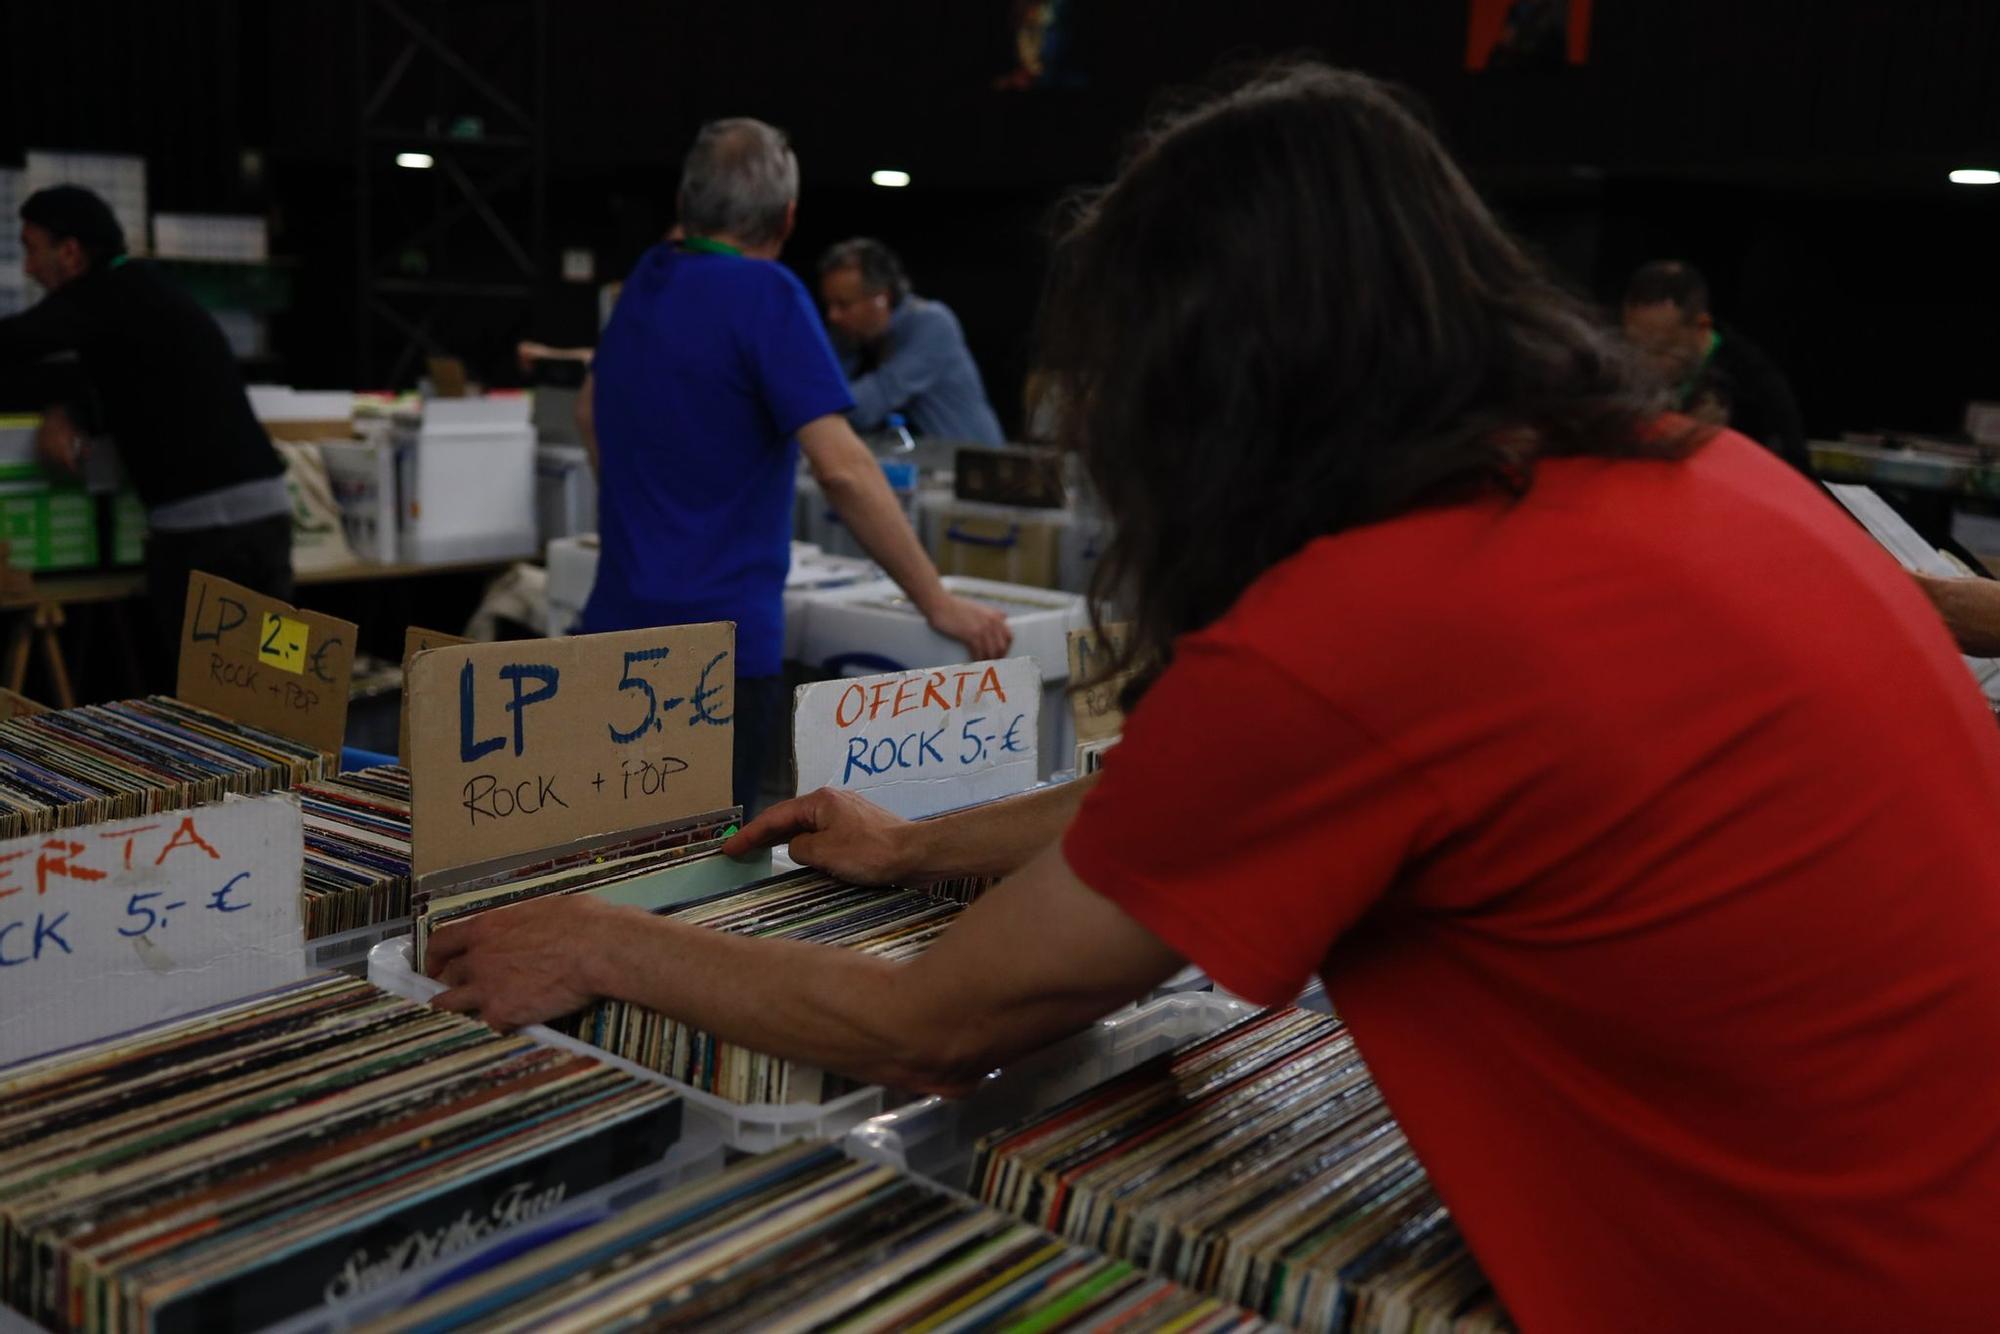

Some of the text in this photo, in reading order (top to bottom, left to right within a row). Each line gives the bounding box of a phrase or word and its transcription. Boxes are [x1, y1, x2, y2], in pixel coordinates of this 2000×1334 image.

[193, 582, 247, 646] LP
[209, 653, 258, 693] ROCK
[285, 681, 319, 715] POP
[459, 657, 560, 763] LP
[836, 666, 1006, 729] OFERTA
[843, 728, 945, 786] ROCK
[462, 756, 689, 825] ROCK + POP
[205, 872, 252, 913] €
